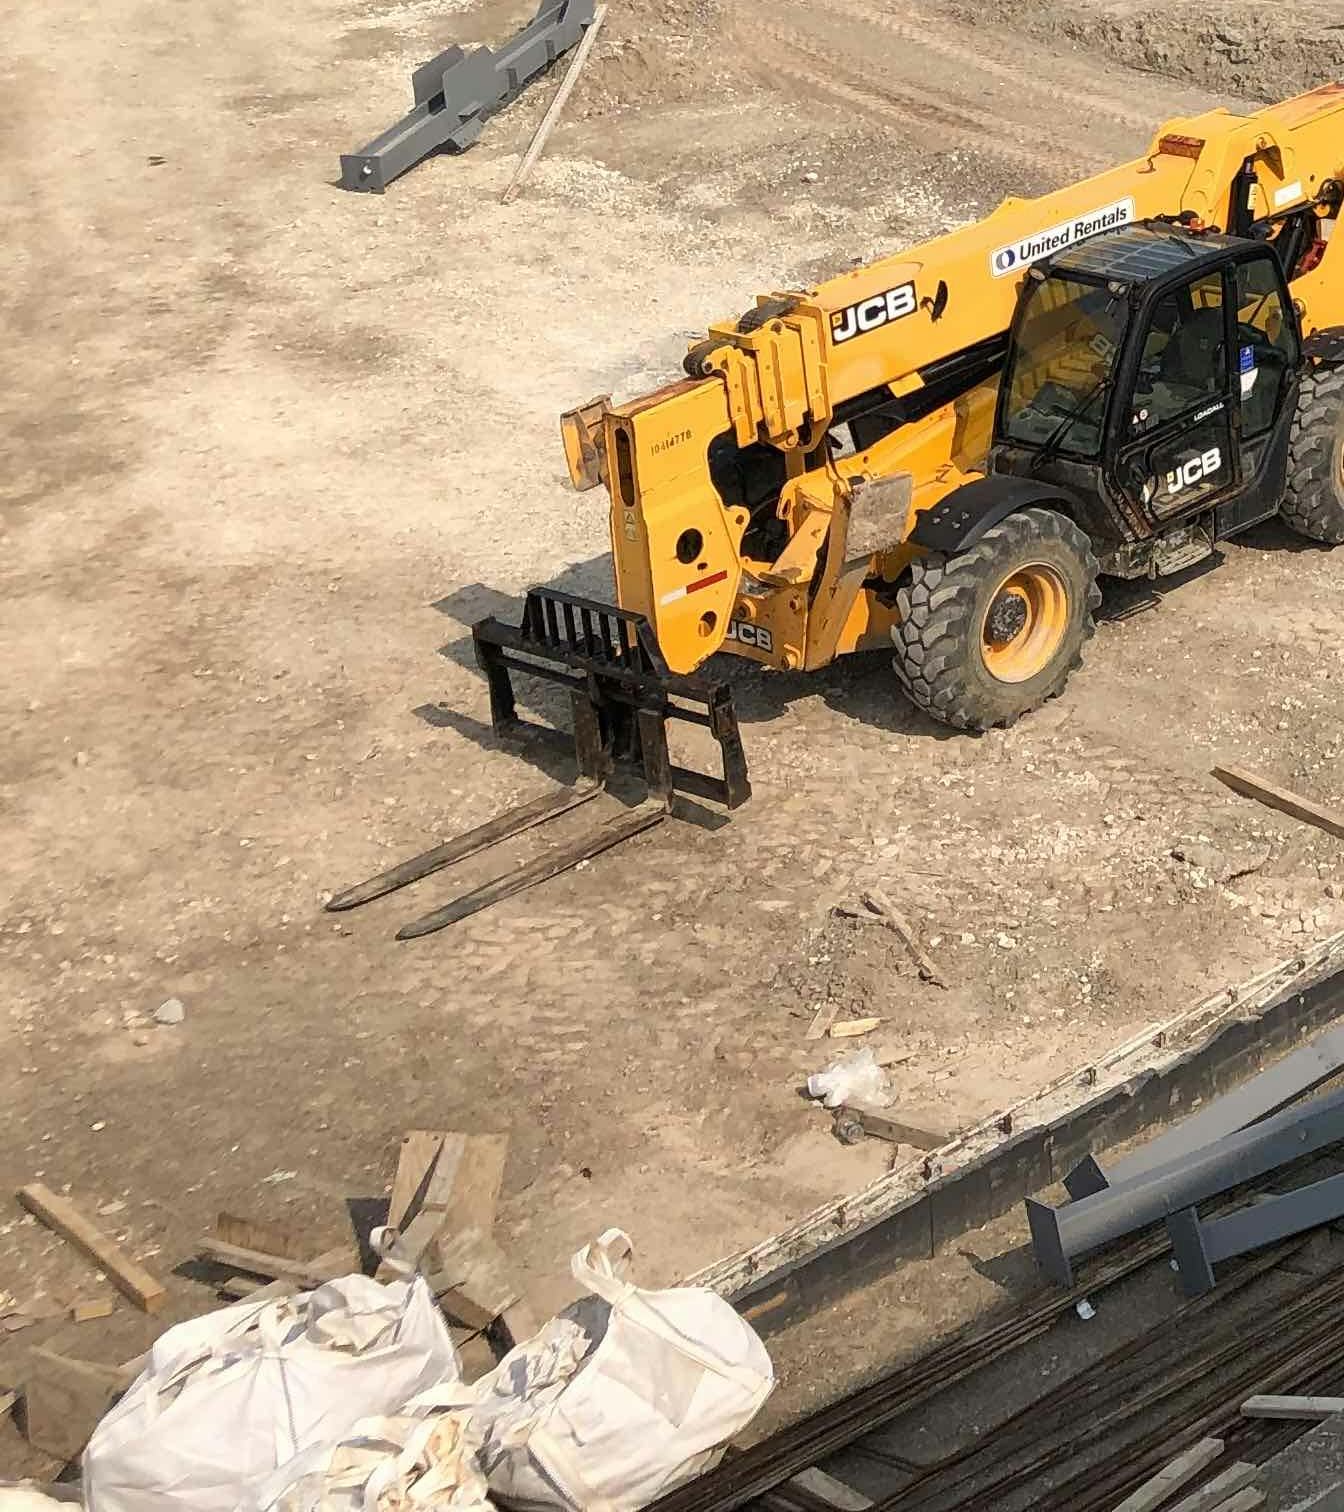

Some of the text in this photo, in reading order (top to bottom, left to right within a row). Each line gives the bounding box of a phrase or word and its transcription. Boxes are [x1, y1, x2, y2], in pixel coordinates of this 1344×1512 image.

[1019, 207, 1127, 260] United Rentals
[832, 284, 916, 342] JCB
[1193, 402, 1225, 421] LOADALL
[1166, 447, 1222, 494] JCB
[725, 619, 772, 652] JCB
